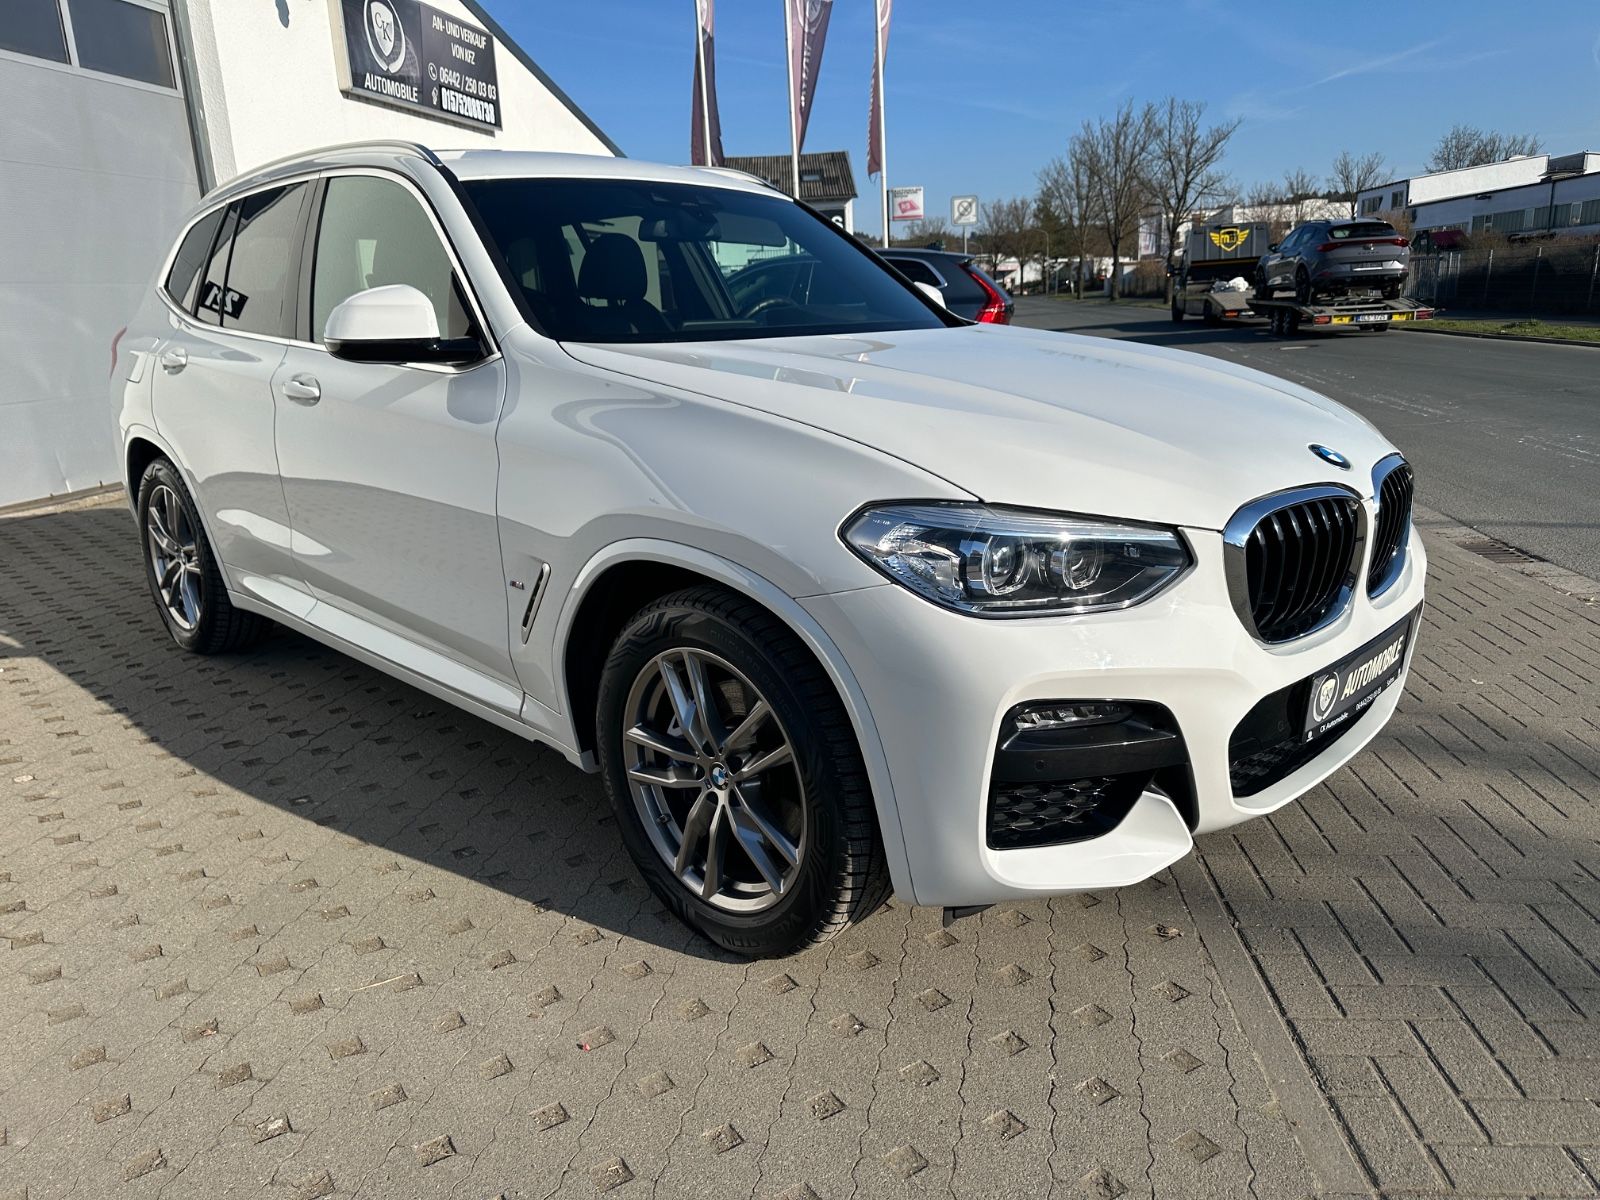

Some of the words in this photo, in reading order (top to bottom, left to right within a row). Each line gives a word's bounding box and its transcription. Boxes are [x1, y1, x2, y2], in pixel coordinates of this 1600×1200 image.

[432, 15, 445, 32] AN-
[445, 20, 460, 38] UND
[460, 26, 487, 50] VERKAUF
[451, 42, 464, 61] VON
[464, 49, 476, 65] KFZ
[364, 73, 419, 103] AUTOMOBILE
[439, 66, 461, 88] 06442
[465, 76, 478, 94] 250
[478, 81, 487, 97] 03
[487, 84, 497, 100] 03
[1340, 634, 1404, 701] AUTOMOBILE
